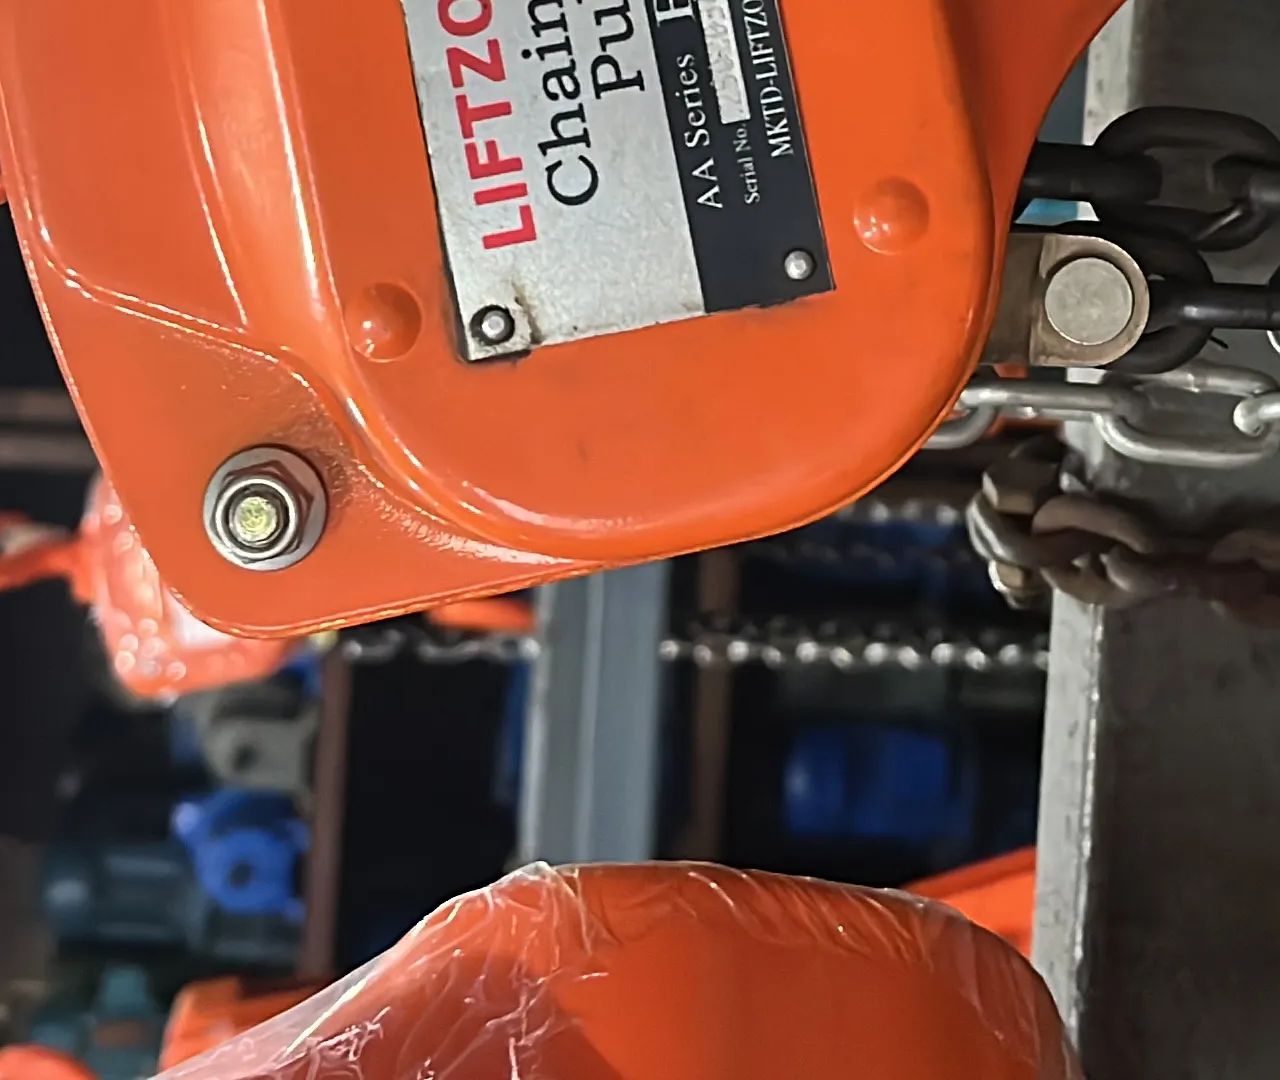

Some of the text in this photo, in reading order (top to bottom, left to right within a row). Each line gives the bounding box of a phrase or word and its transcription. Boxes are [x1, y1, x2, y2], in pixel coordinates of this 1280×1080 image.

[674, 53, 724, 209] AA Series
[732, 128, 751, 153] No.
[737, 156, 761, 204] Serial
